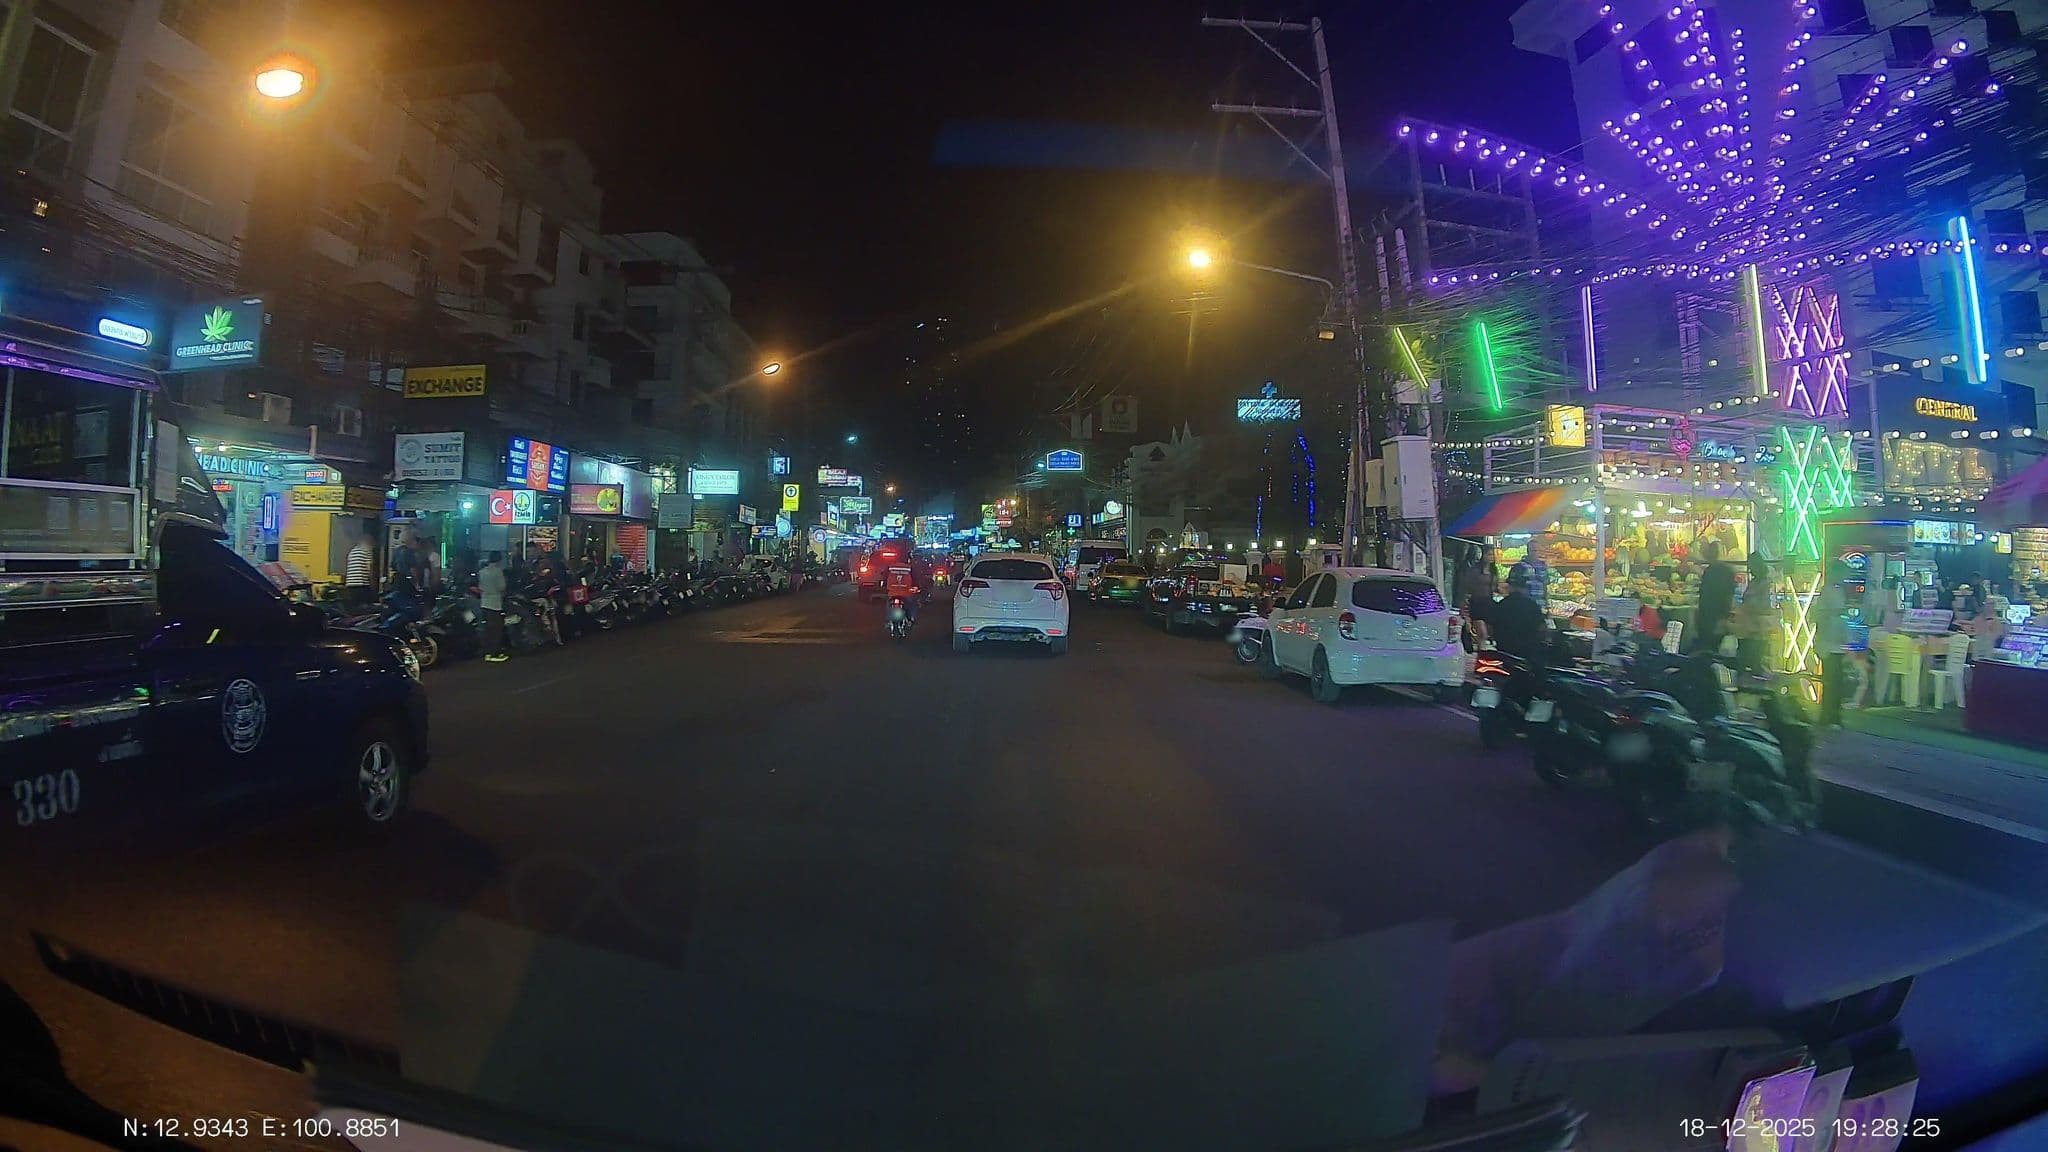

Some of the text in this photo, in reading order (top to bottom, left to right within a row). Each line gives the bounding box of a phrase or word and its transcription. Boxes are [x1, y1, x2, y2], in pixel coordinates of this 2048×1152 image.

[177, 340, 254, 357] GREENHEAD CLINIC
[407, 377, 483, 395] EXCHANGE
[1916, 397, 1978, 421] CENTRAL
[14, 768, 80, 826] 330
